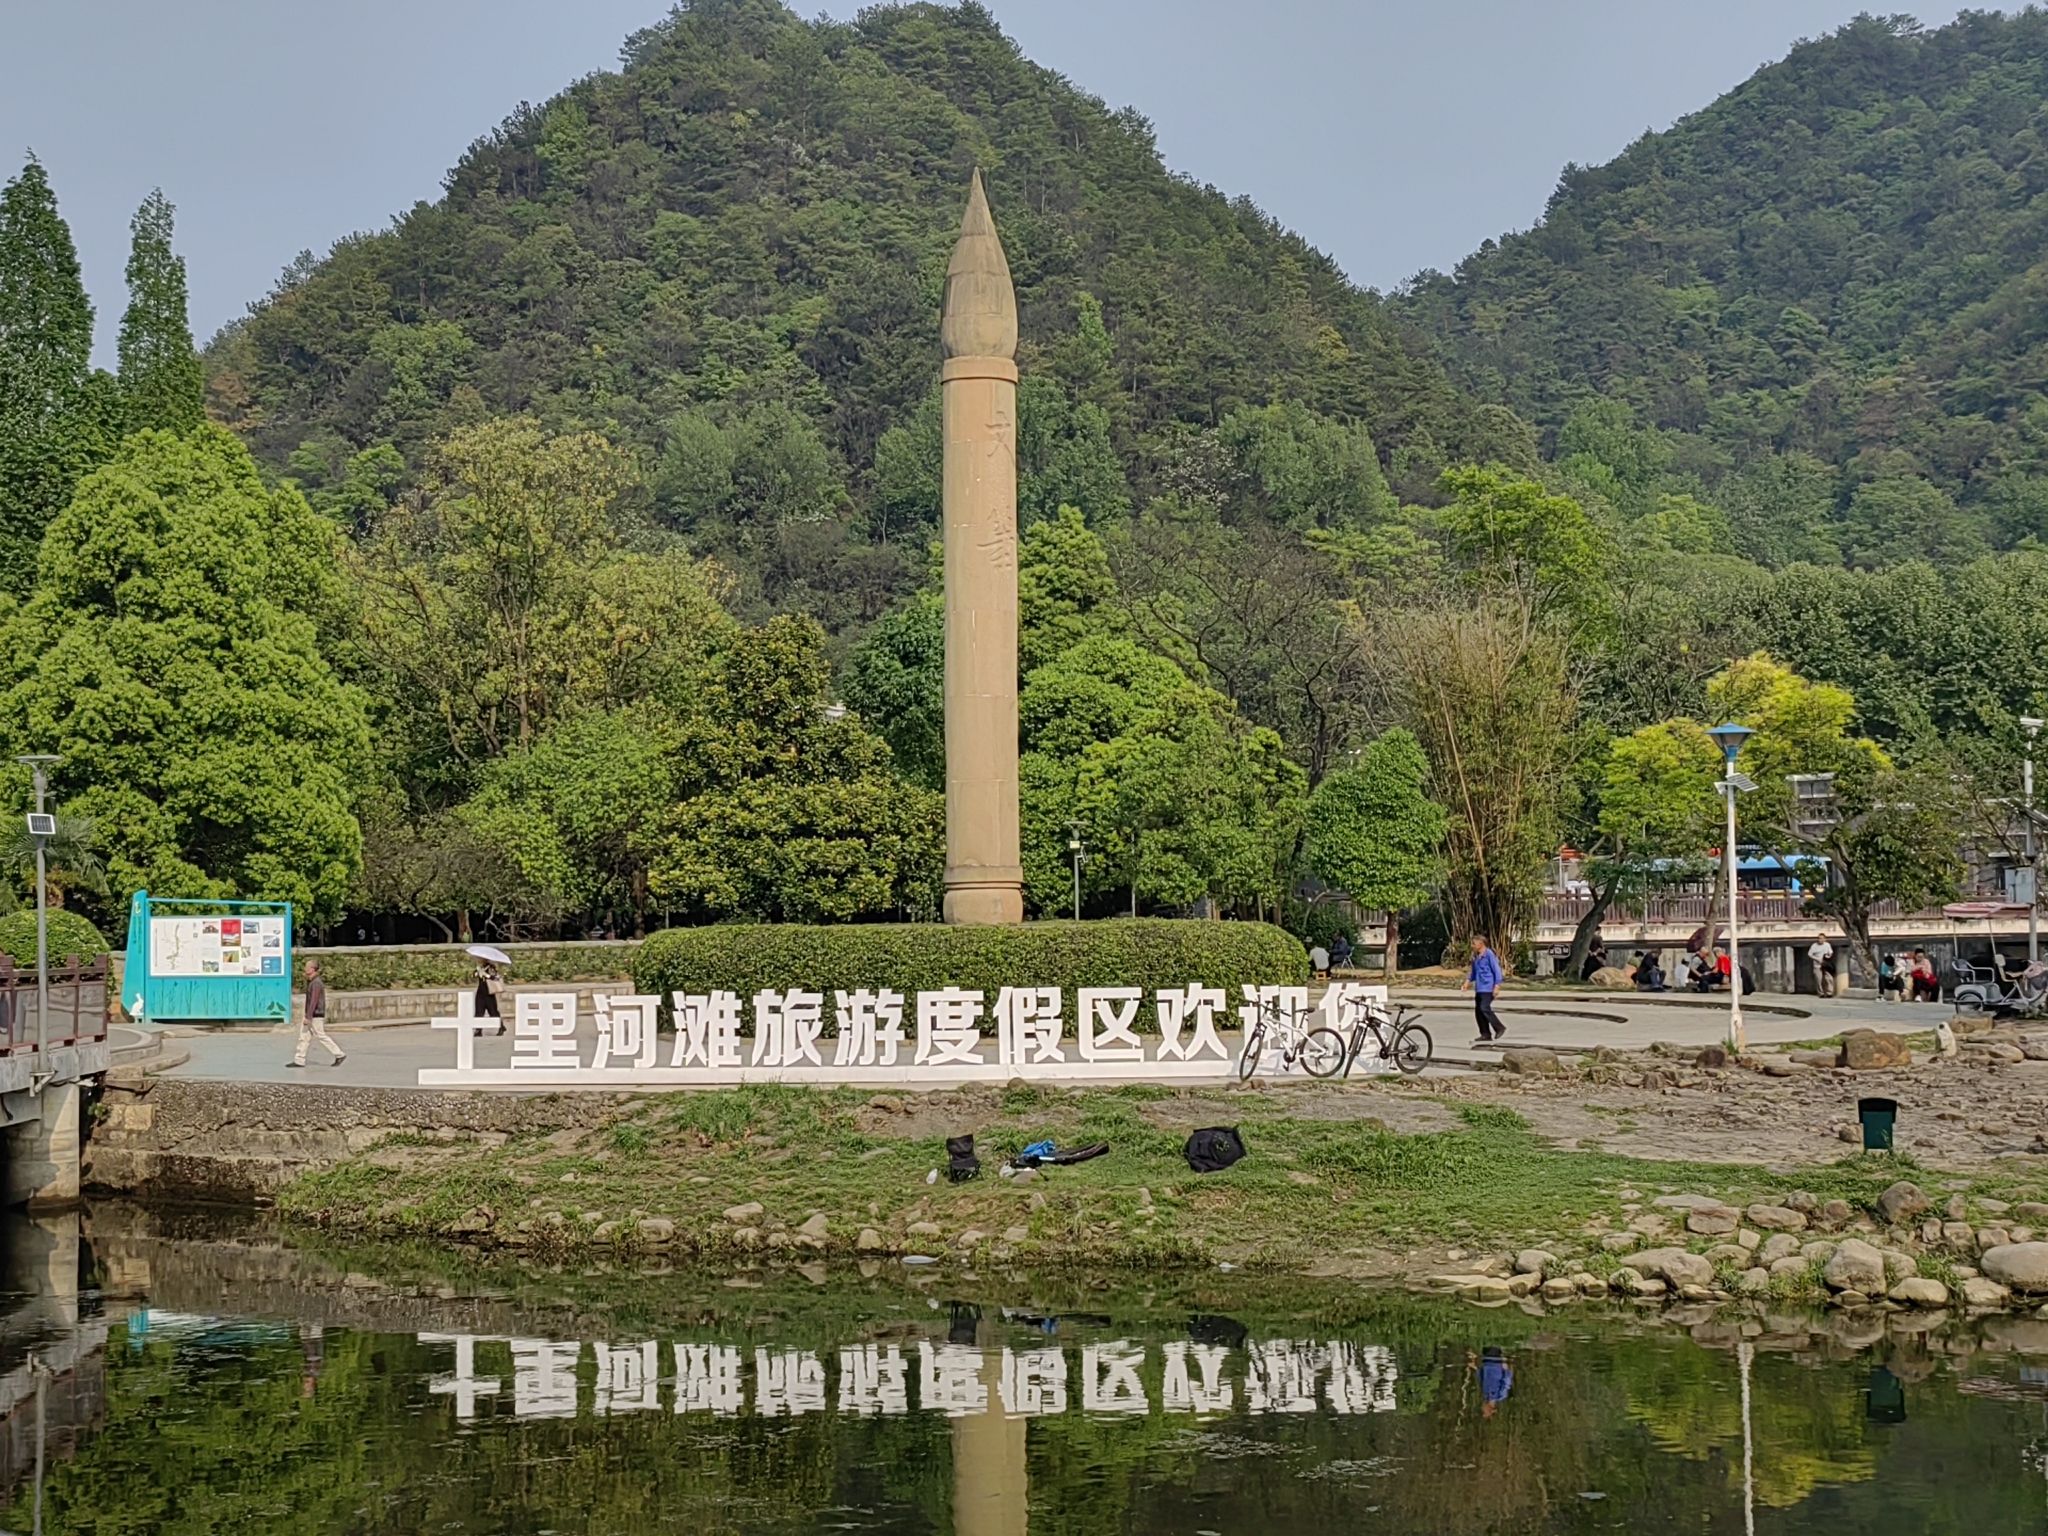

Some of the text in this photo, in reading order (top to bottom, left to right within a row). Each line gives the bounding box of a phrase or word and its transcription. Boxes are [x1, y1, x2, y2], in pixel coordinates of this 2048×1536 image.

[430, 982, 1391, 1069] 十里河滩旅游度假区欢迎你
